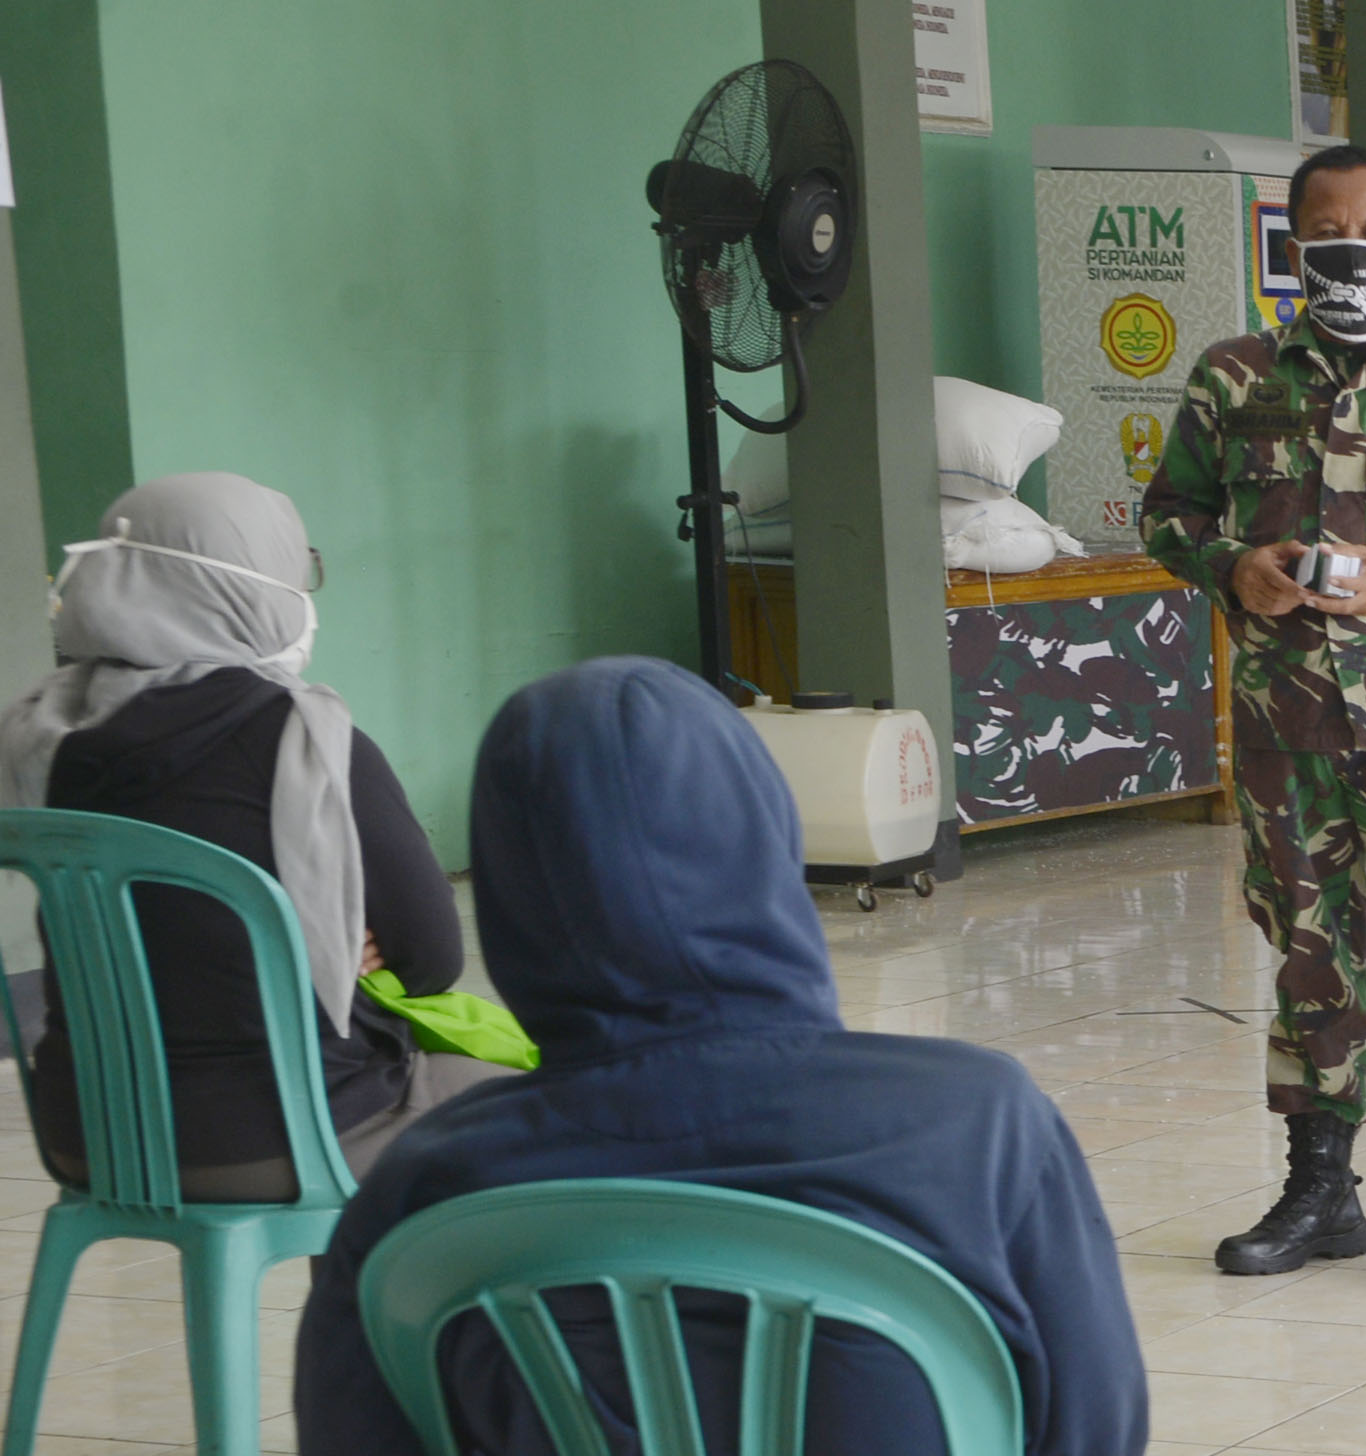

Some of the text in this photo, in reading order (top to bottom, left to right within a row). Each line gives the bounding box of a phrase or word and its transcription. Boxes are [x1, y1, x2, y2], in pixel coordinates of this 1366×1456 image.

[1088, 205, 1184, 248] ATM
[1086, 249, 1185, 267] PERTANIAN
[1087, 268, 1185, 282] SI KOMANDAN
[1147, 386, 1184, 394] PERTANIA
